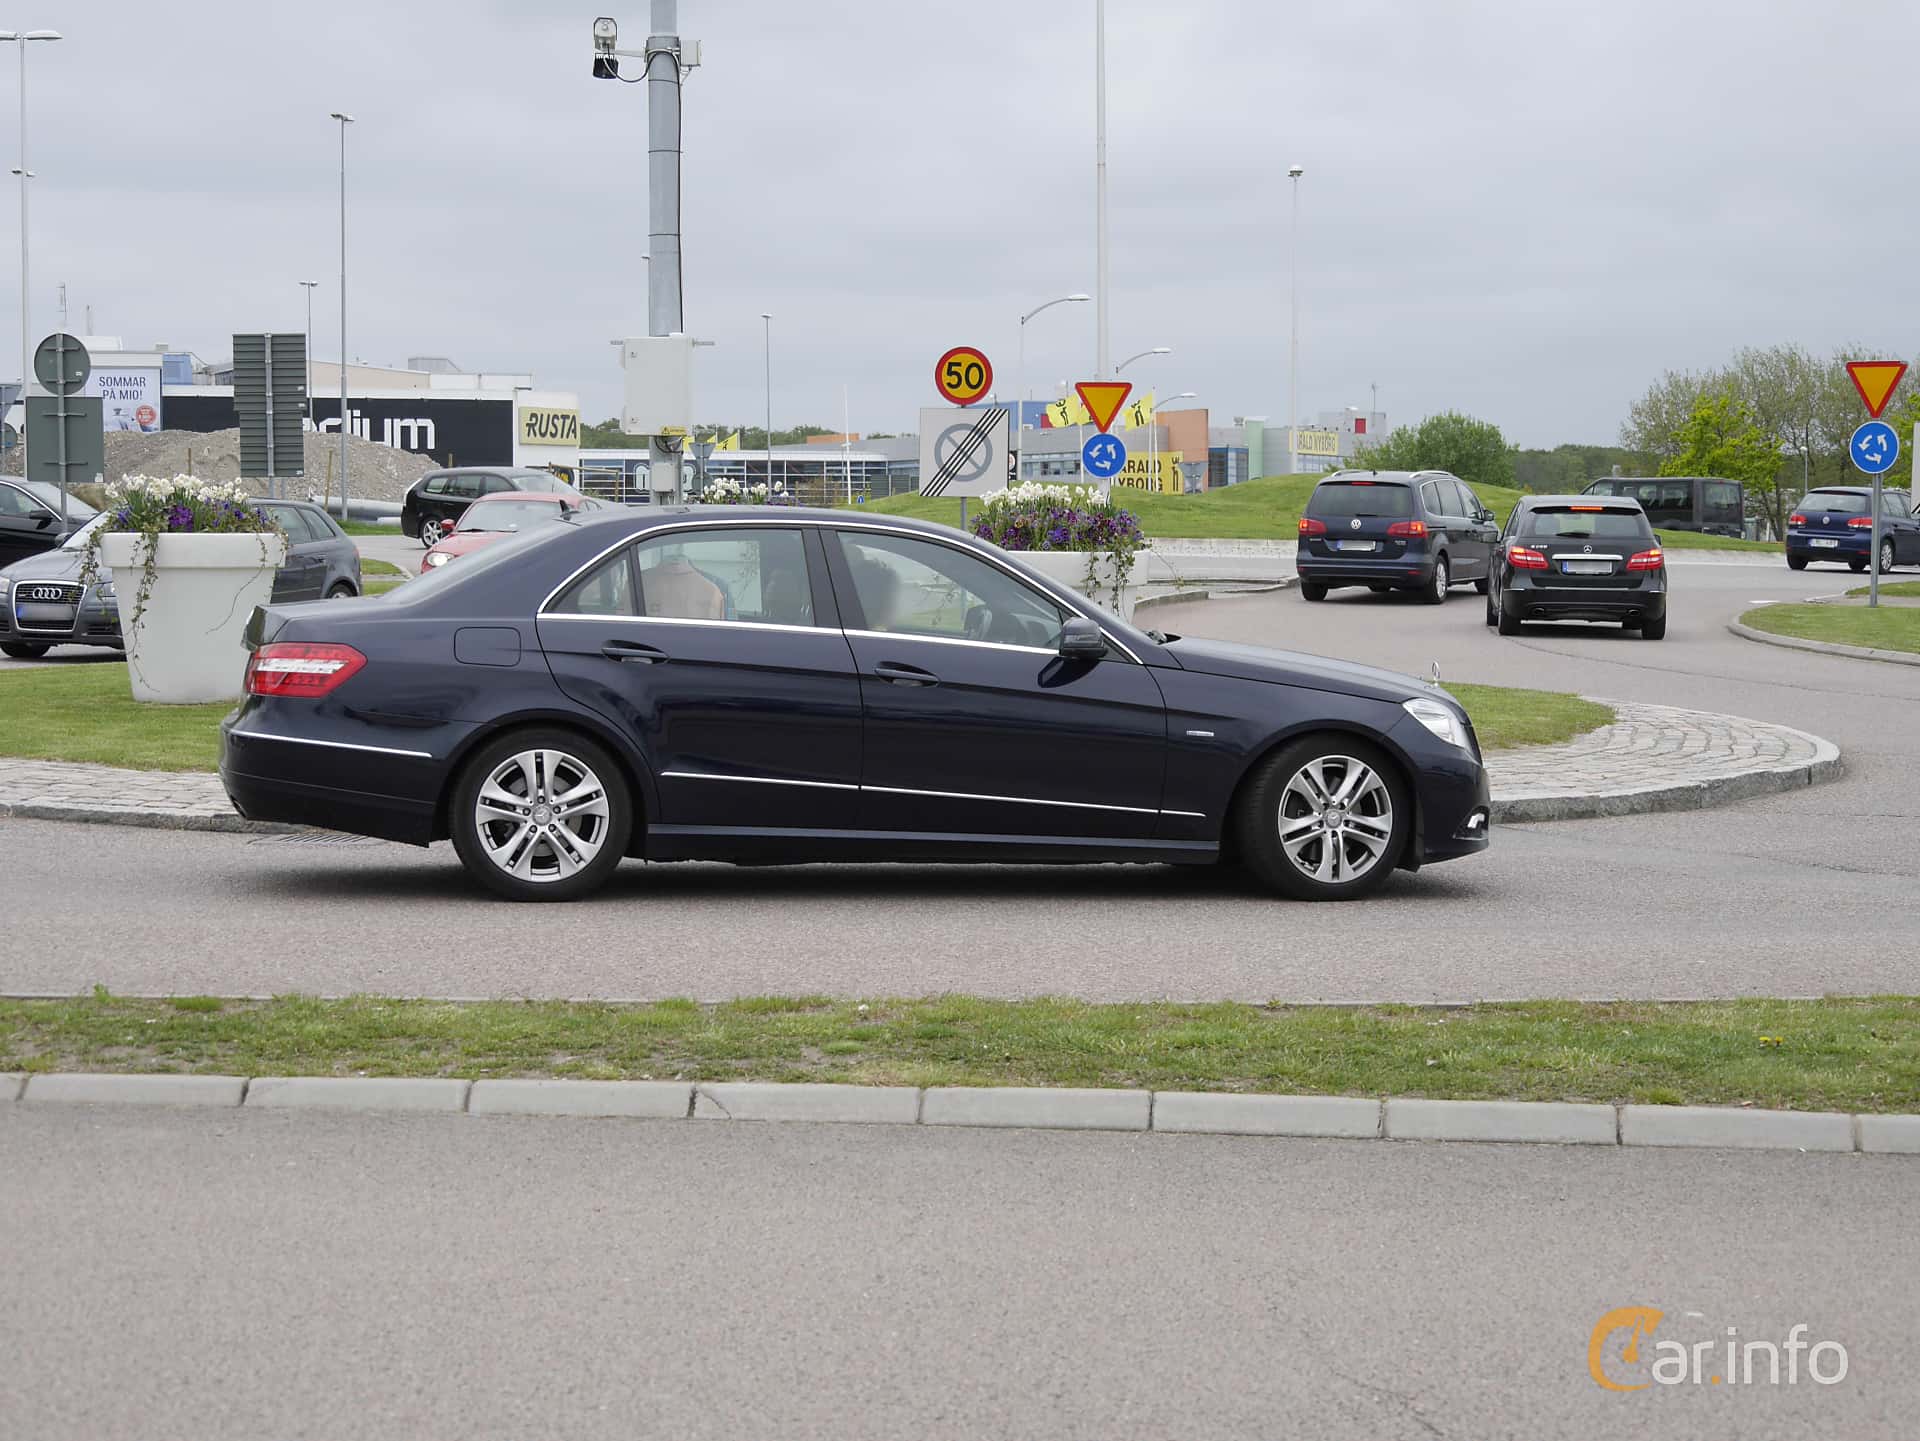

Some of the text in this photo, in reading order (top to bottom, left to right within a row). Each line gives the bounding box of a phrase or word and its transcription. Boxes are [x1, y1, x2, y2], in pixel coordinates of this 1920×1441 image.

[98, 376, 146, 387] SOMMAR
[946, 361, 984, 390] 50
[102, 387, 116, 400] PÅ
[525, 412, 577, 440] RUSTA
